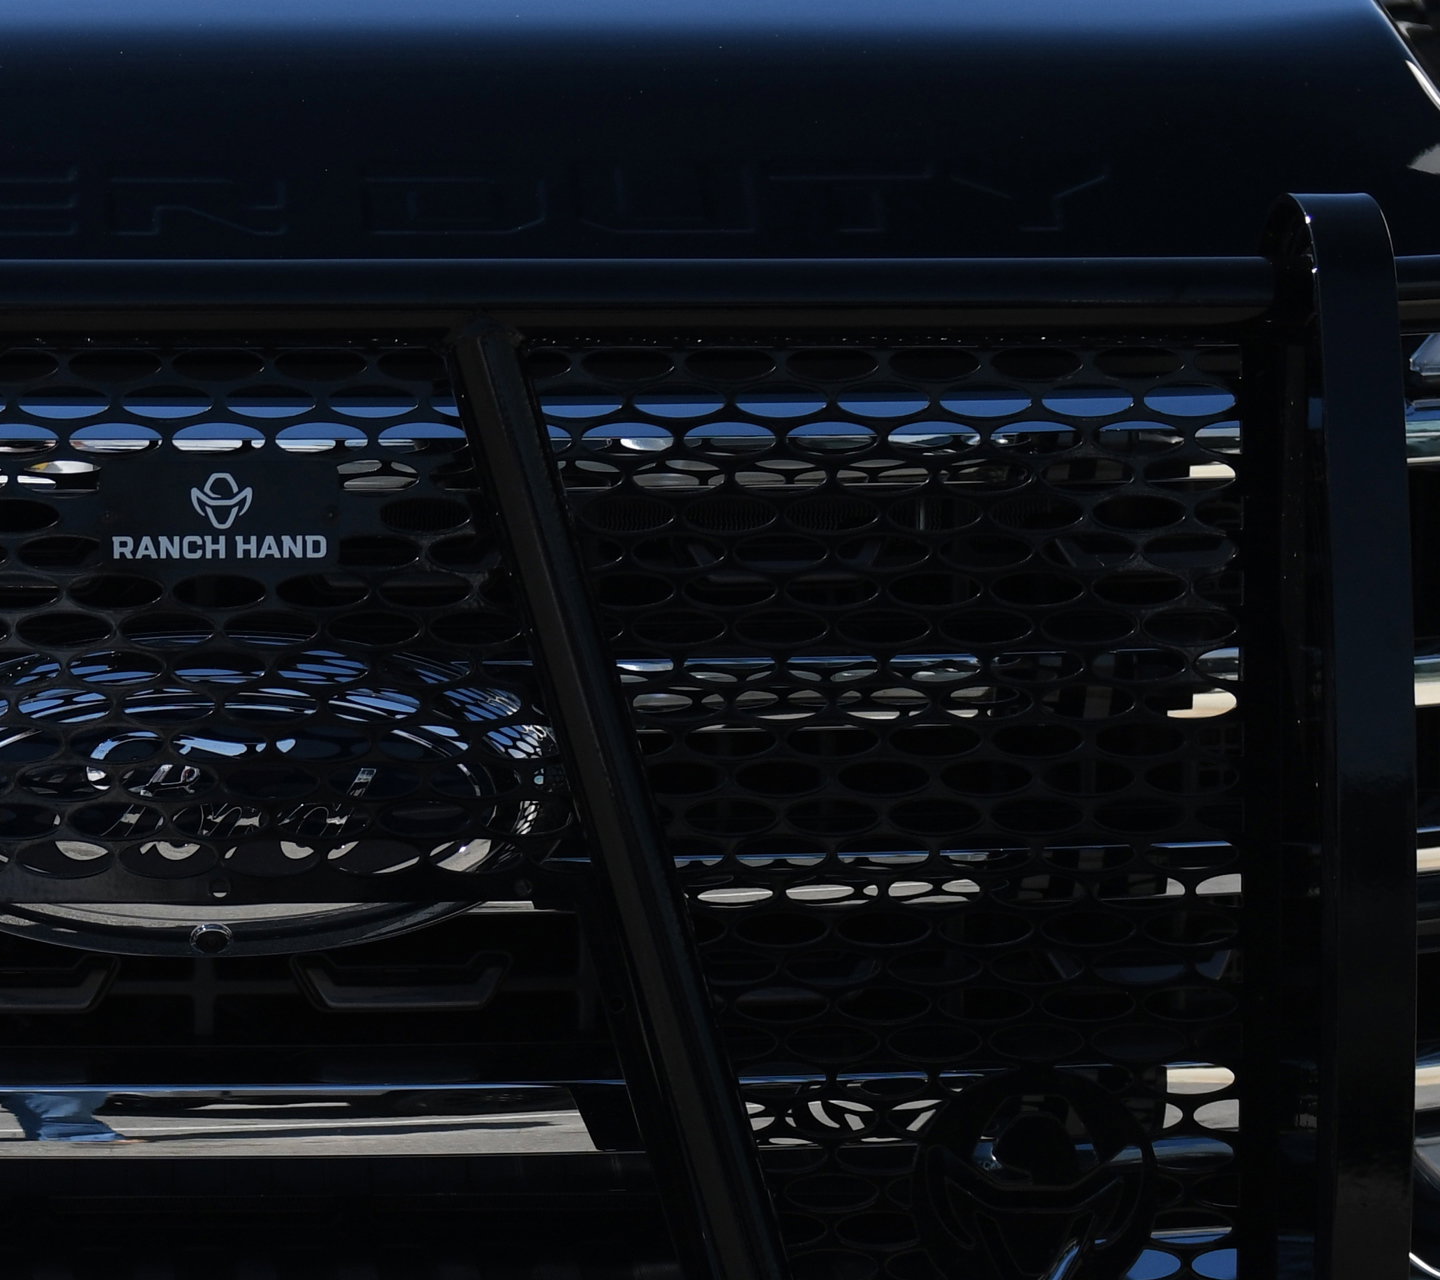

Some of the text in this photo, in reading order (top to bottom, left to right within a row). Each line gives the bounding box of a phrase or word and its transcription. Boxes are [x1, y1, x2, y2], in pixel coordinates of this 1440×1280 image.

[356, 160, 1113, 235] DUTY
[111, 534, 328, 560] RANCH HAND
